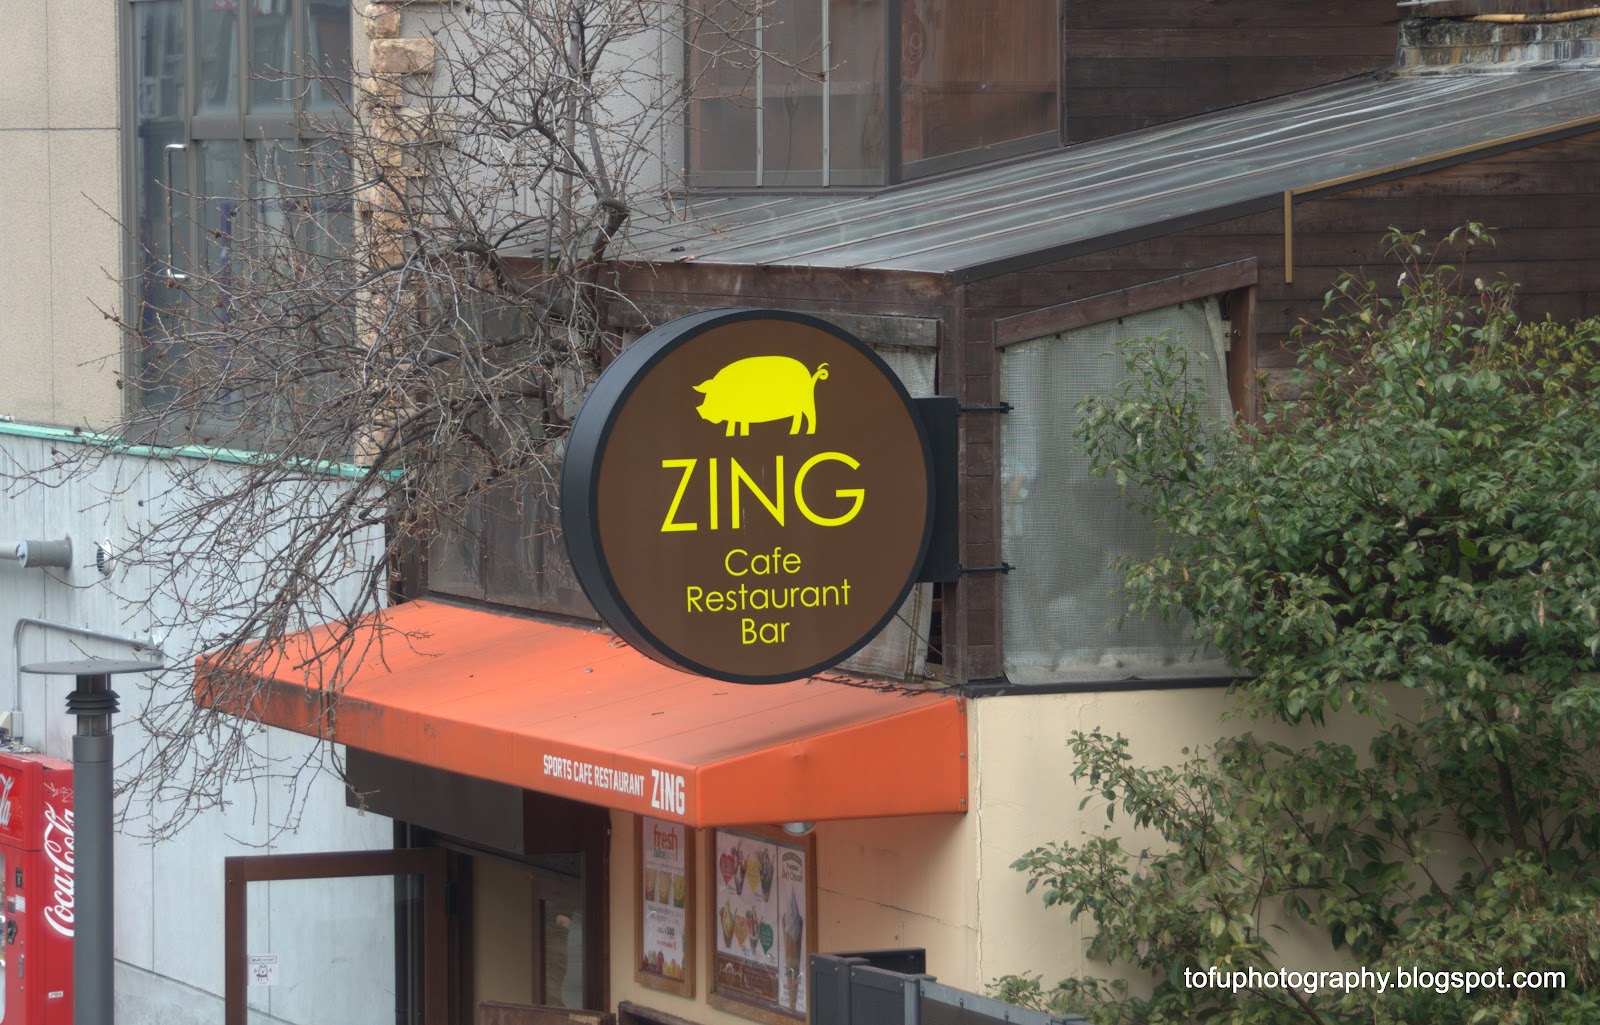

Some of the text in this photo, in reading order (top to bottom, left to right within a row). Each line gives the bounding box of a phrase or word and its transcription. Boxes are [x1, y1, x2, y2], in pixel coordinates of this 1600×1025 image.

[661, 452, 865, 532] ZING
[725, 547, 802, 577] Cafe
[687, 579, 851, 612] Restaurant
[741, 618, 790, 645] Bar
[543, 754, 686, 815] SPORTS CAFE RESTAURANT ZING
[653, 823, 678, 862] fresh
